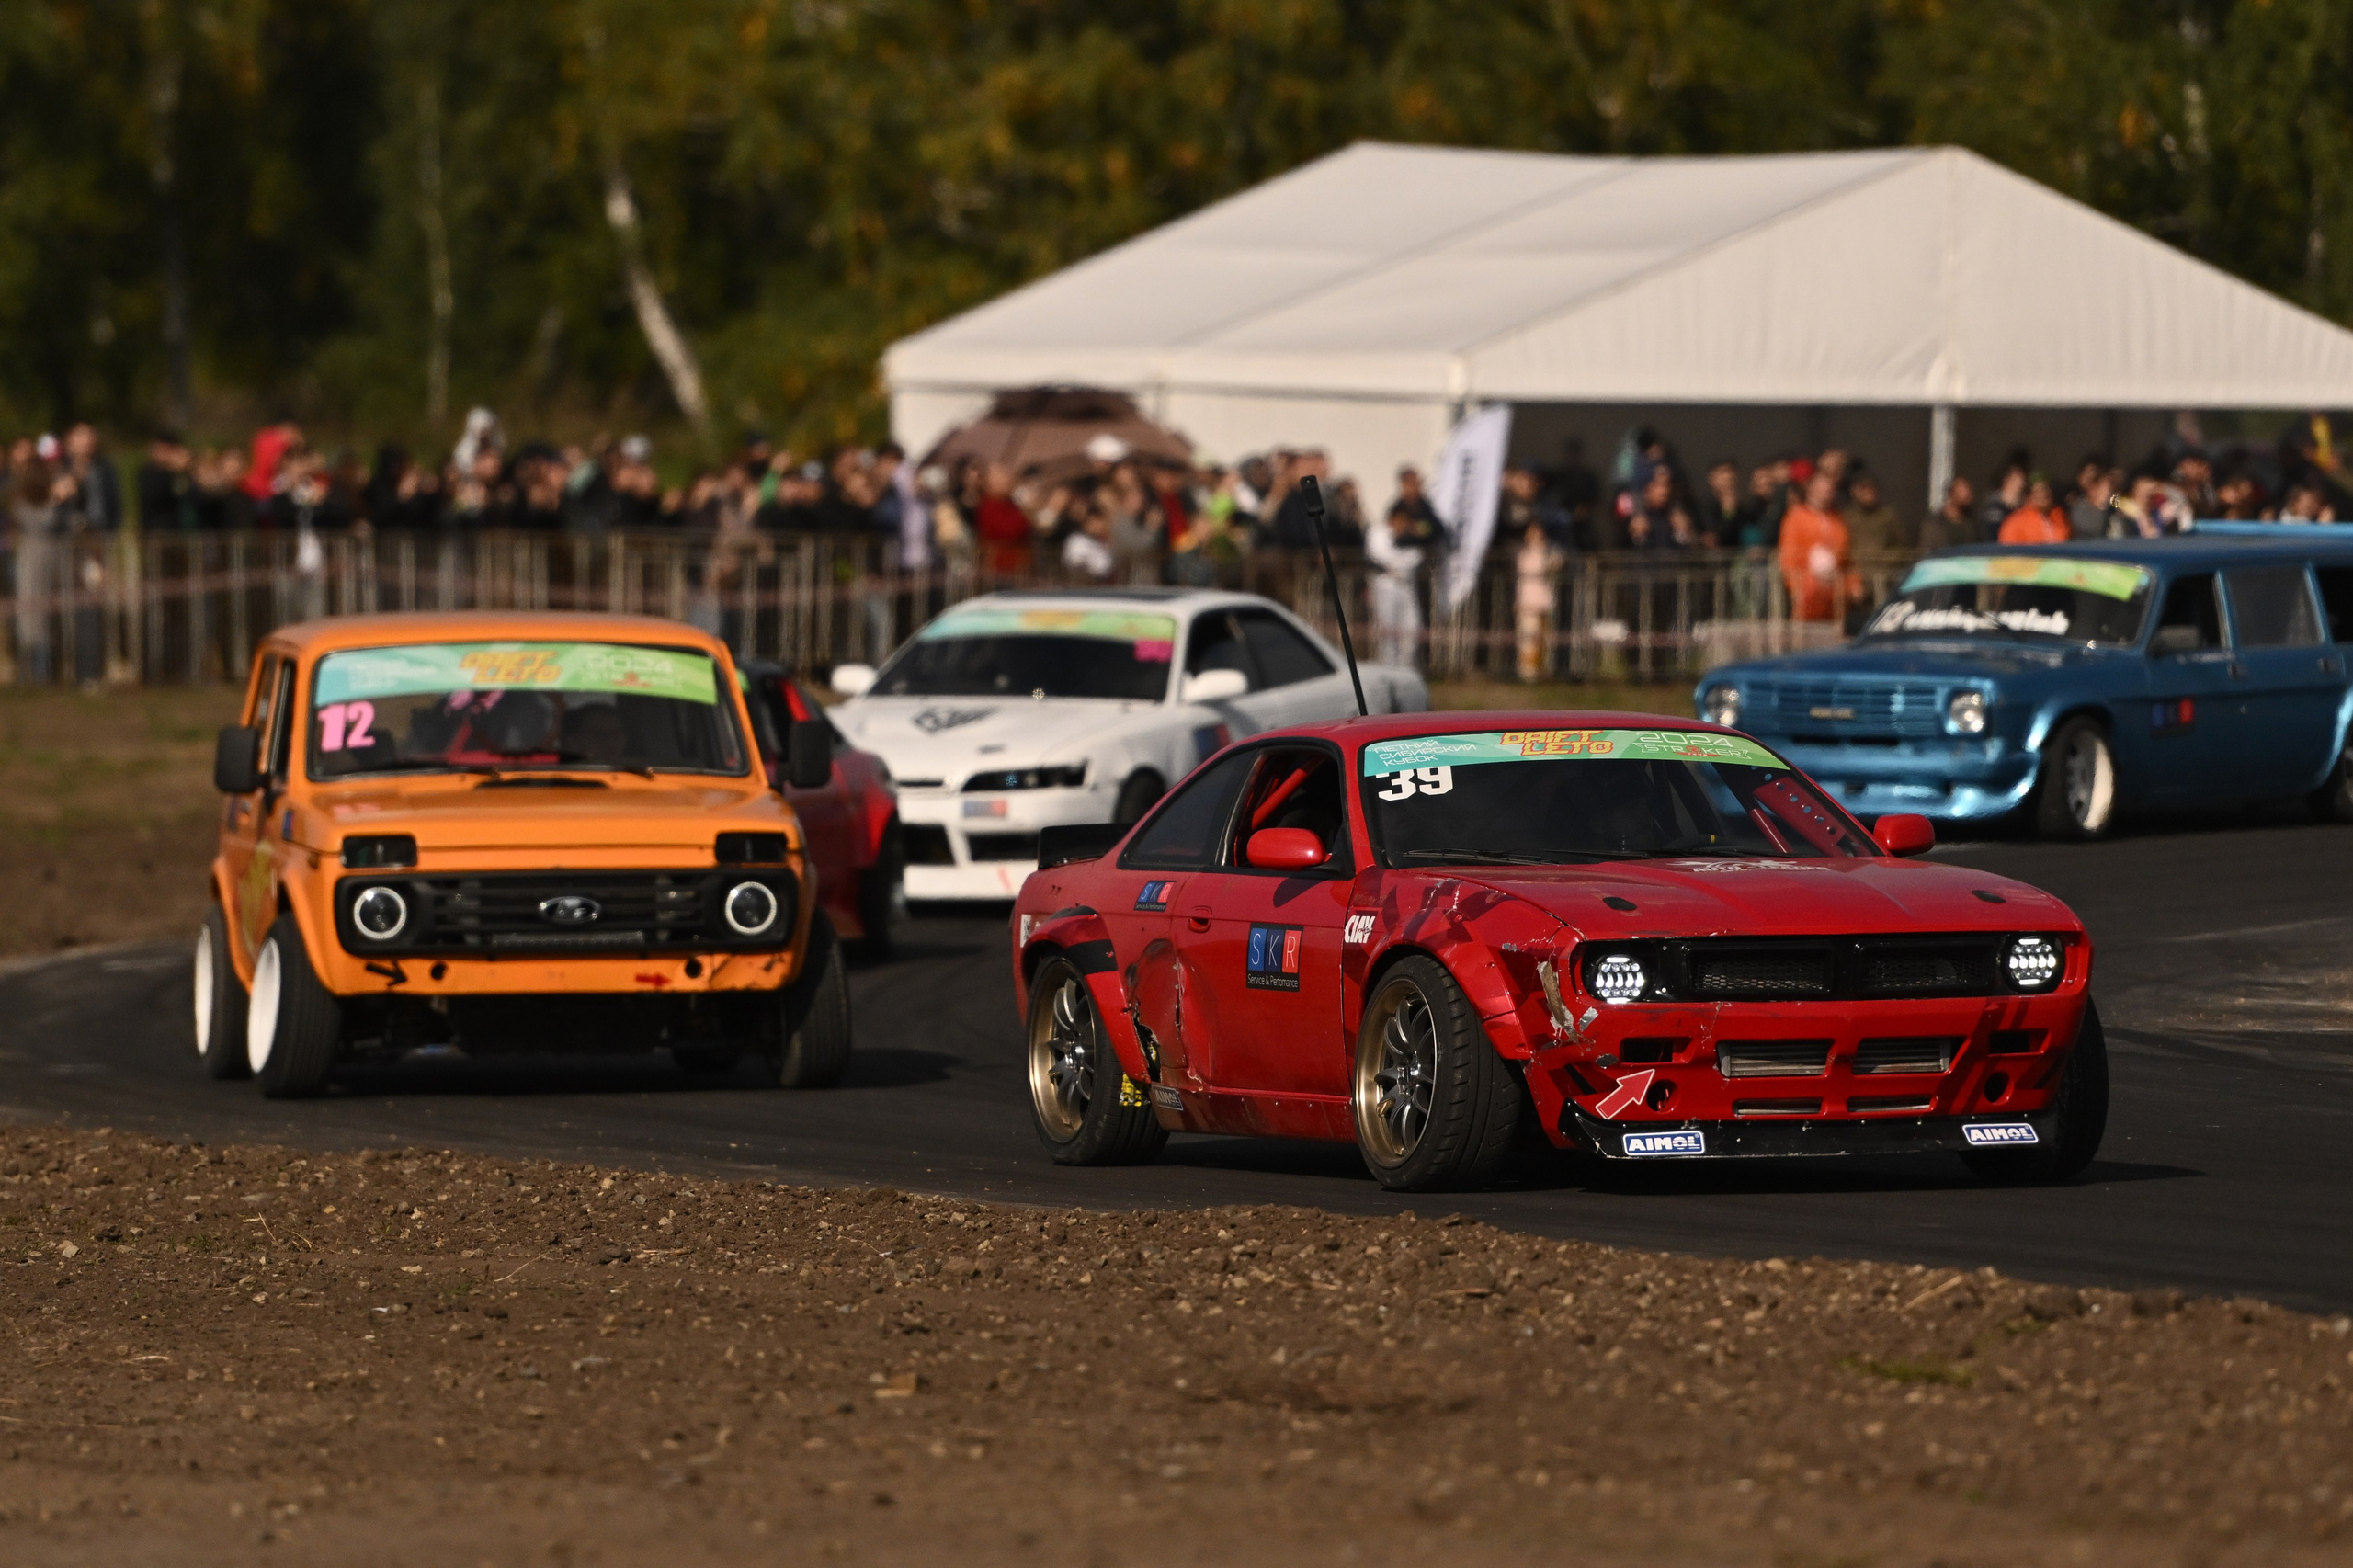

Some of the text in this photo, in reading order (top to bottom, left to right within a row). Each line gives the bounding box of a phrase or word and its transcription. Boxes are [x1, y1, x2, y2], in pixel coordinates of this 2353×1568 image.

[318, 700, 376, 753] 12
[1500, 730, 1603, 744] DRIFT
[1636, 732, 1733, 748] 2024
[1374, 739, 1439, 754] ЛЕТНИЙ
[1379, 743, 1477, 759] СИБИРСКИЙ
[1520, 741, 1614, 756] LETO
[1382, 754, 1439, 767] КУБОК
[1375, 765, 1453, 801] 39
[1141, 883, 1172, 900] SKR
[1251, 932, 1297, 968] SKR
[1247, 973, 1265, 985] Service
[1265, 975, 1270, 985] &
[1970, 1127, 2034, 1141] AIMOL
[1628, 1136, 1700, 1151] AIMOL
